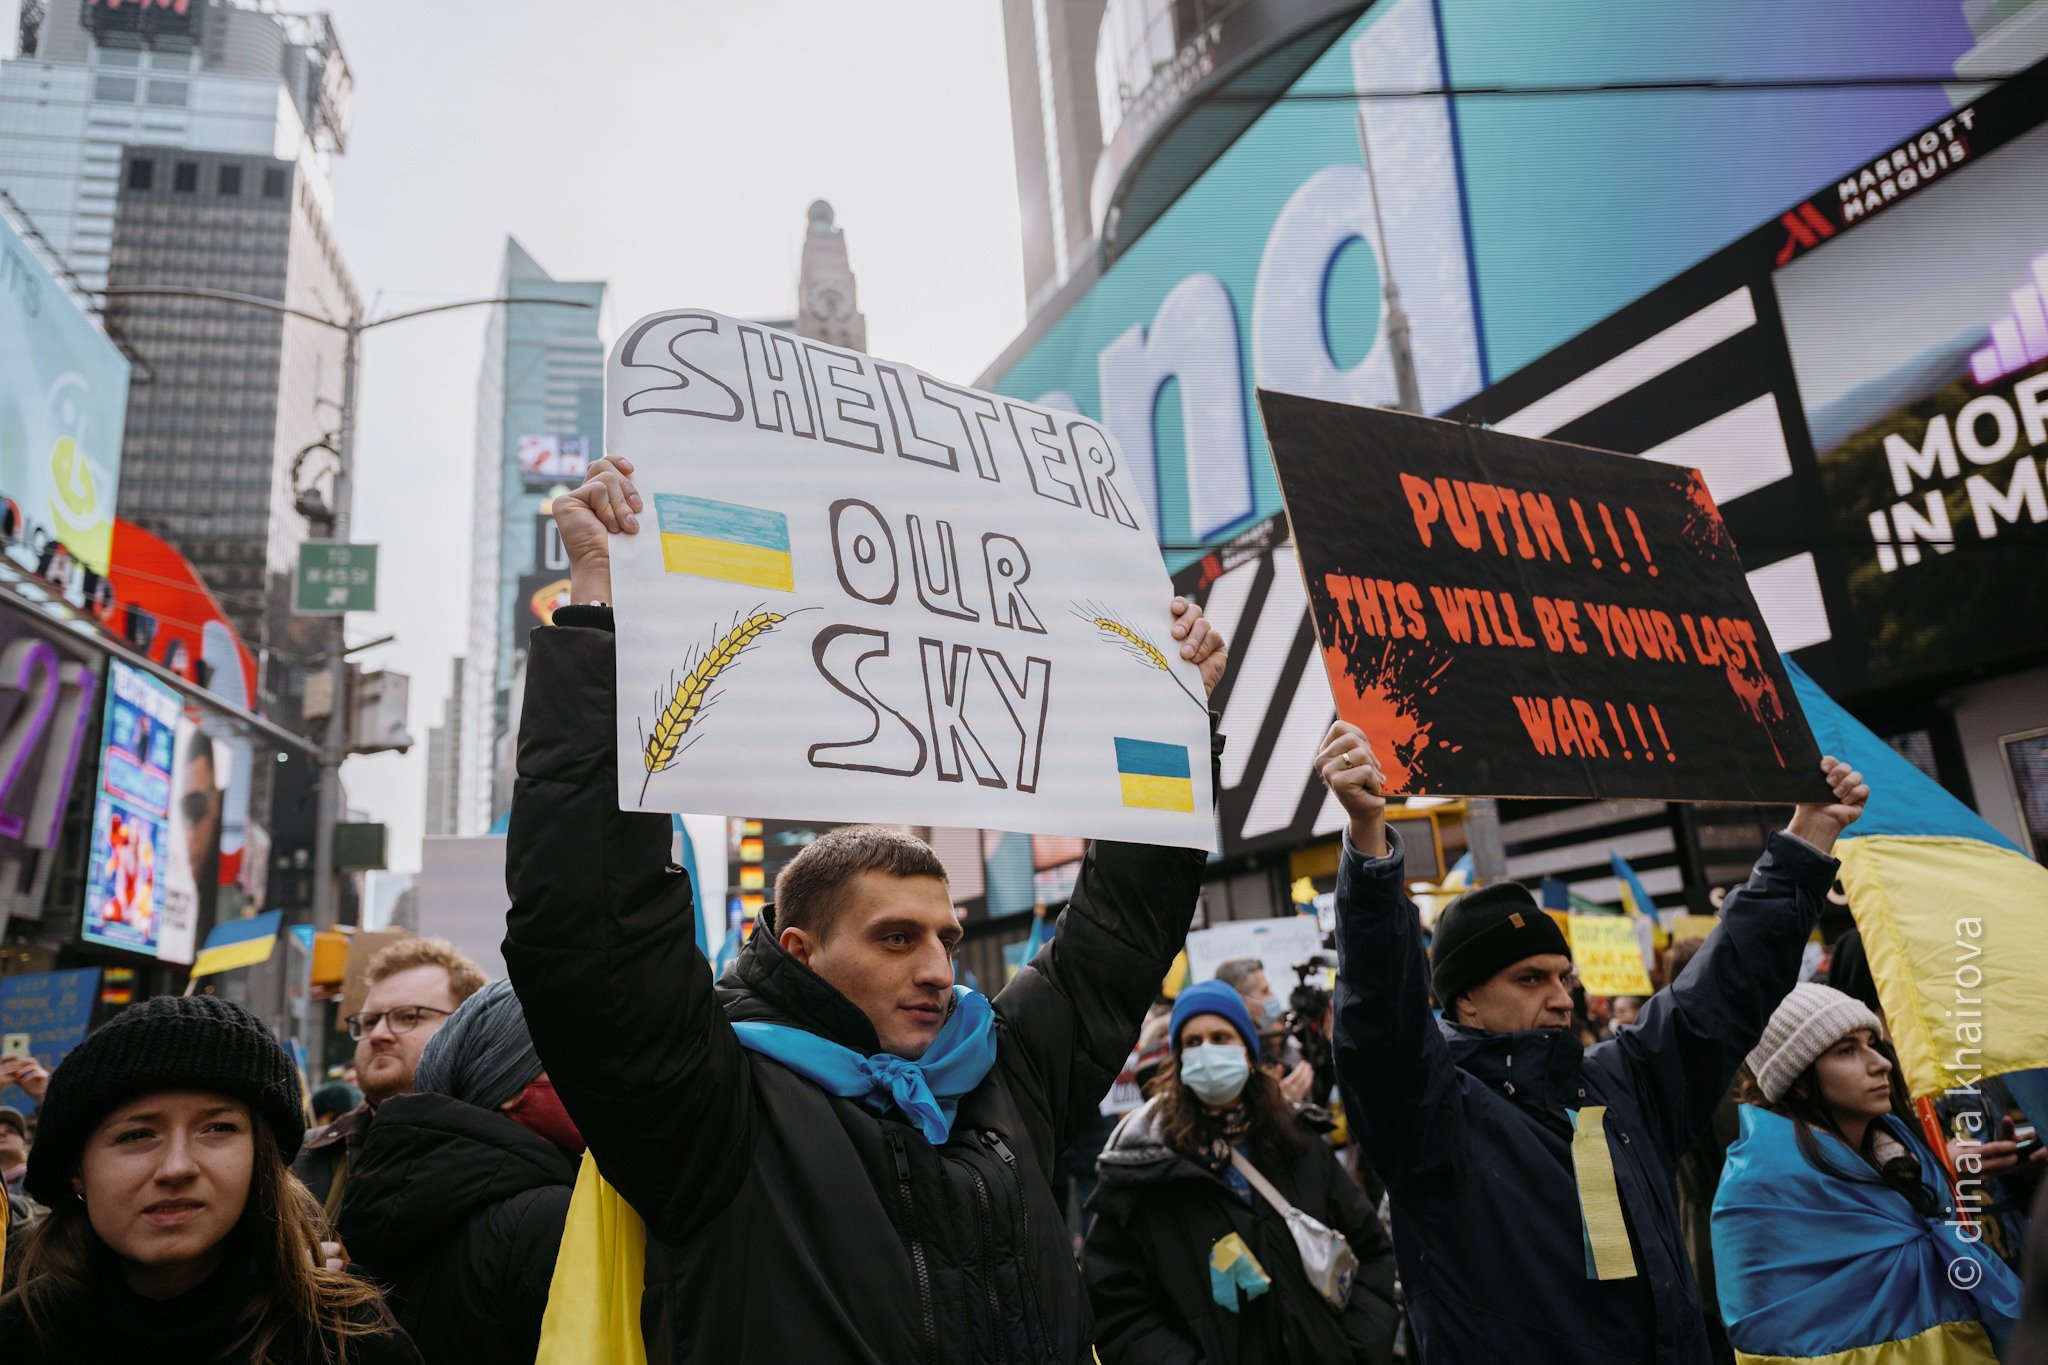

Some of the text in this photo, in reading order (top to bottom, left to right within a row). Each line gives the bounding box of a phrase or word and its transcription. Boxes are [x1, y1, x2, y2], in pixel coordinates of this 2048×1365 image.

[1838, 107, 1975, 201] MARRIOTT
[1843, 141, 1966, 222] MARQUIS
[1033, 0, 1490, 541] nd
[621, 314, 1139, 530] SHELTER
[829, 498, 1047, 634] OUR
[1868, 489, 1956, 574] IN
[1325, 574, 1762, 671] THIS WILL BE YOUR LAST
[808, 623, 1051, 793] SKY
